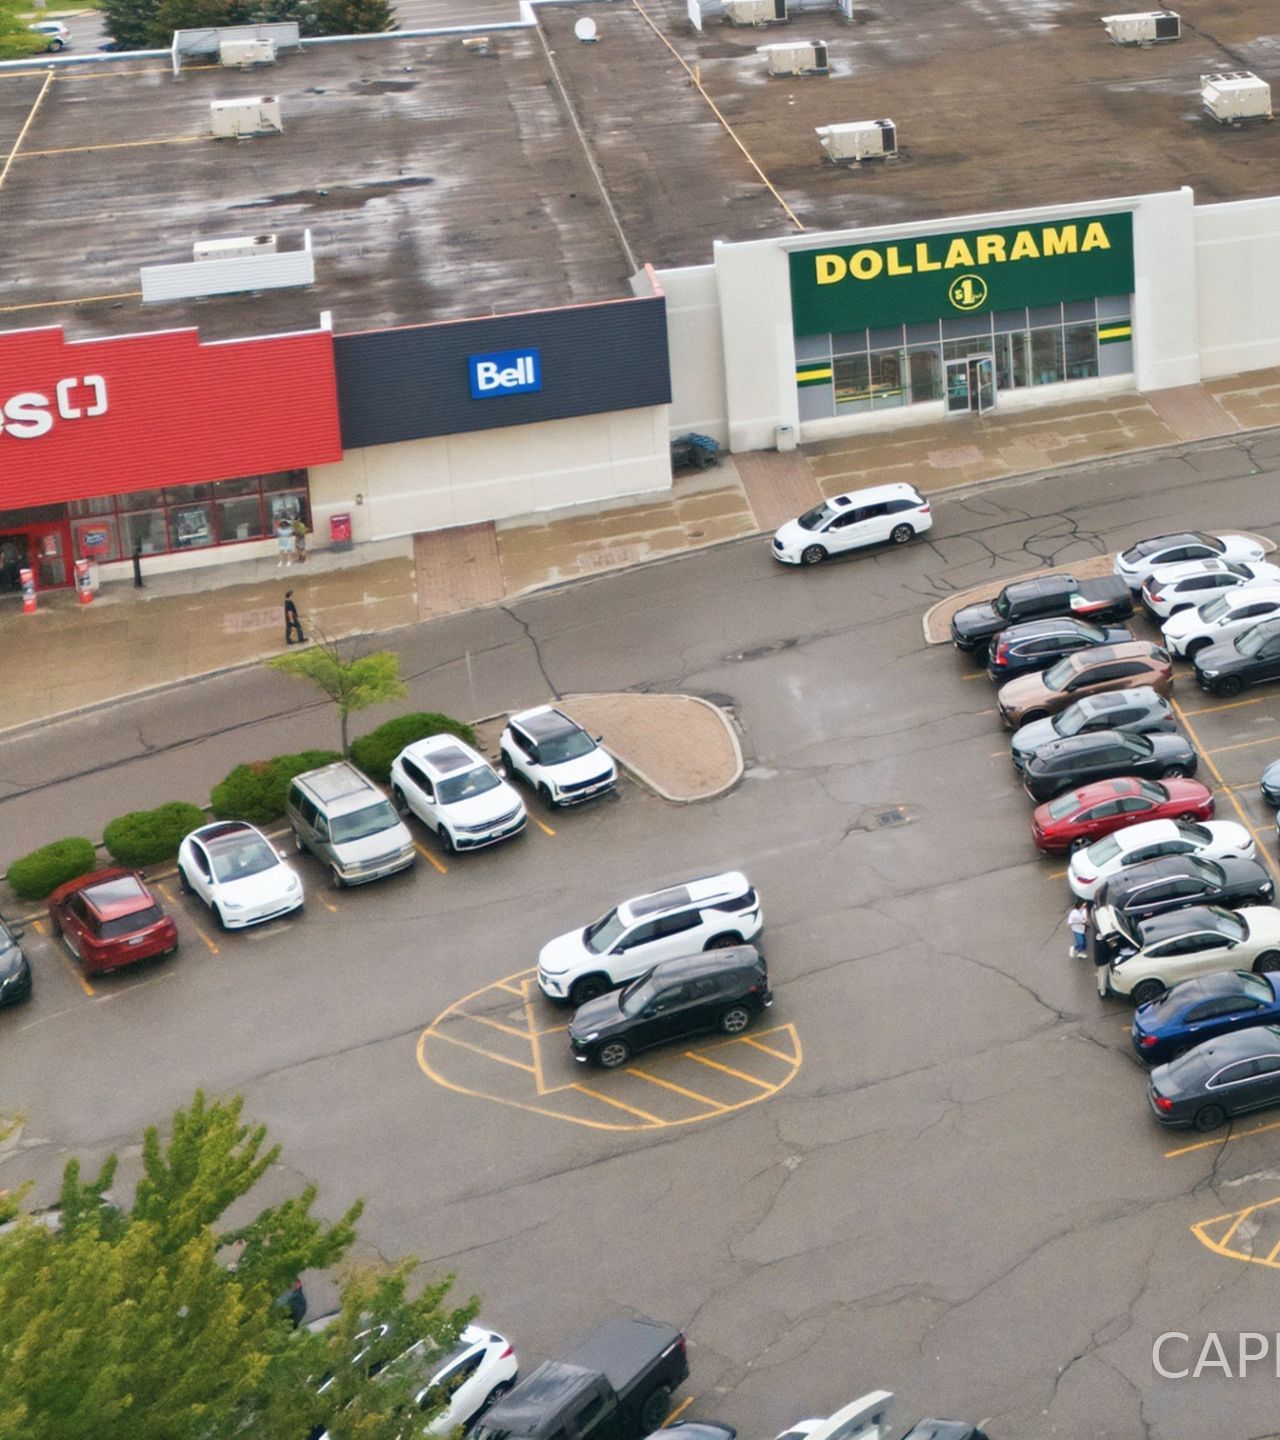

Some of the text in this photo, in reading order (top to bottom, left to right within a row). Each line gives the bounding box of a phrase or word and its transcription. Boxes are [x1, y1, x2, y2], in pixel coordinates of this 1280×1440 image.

[815, 222, 1111, 285] DOLLARAMA
[476, 356, 535, 391] Bell
[0, 392, 53, 439] s
